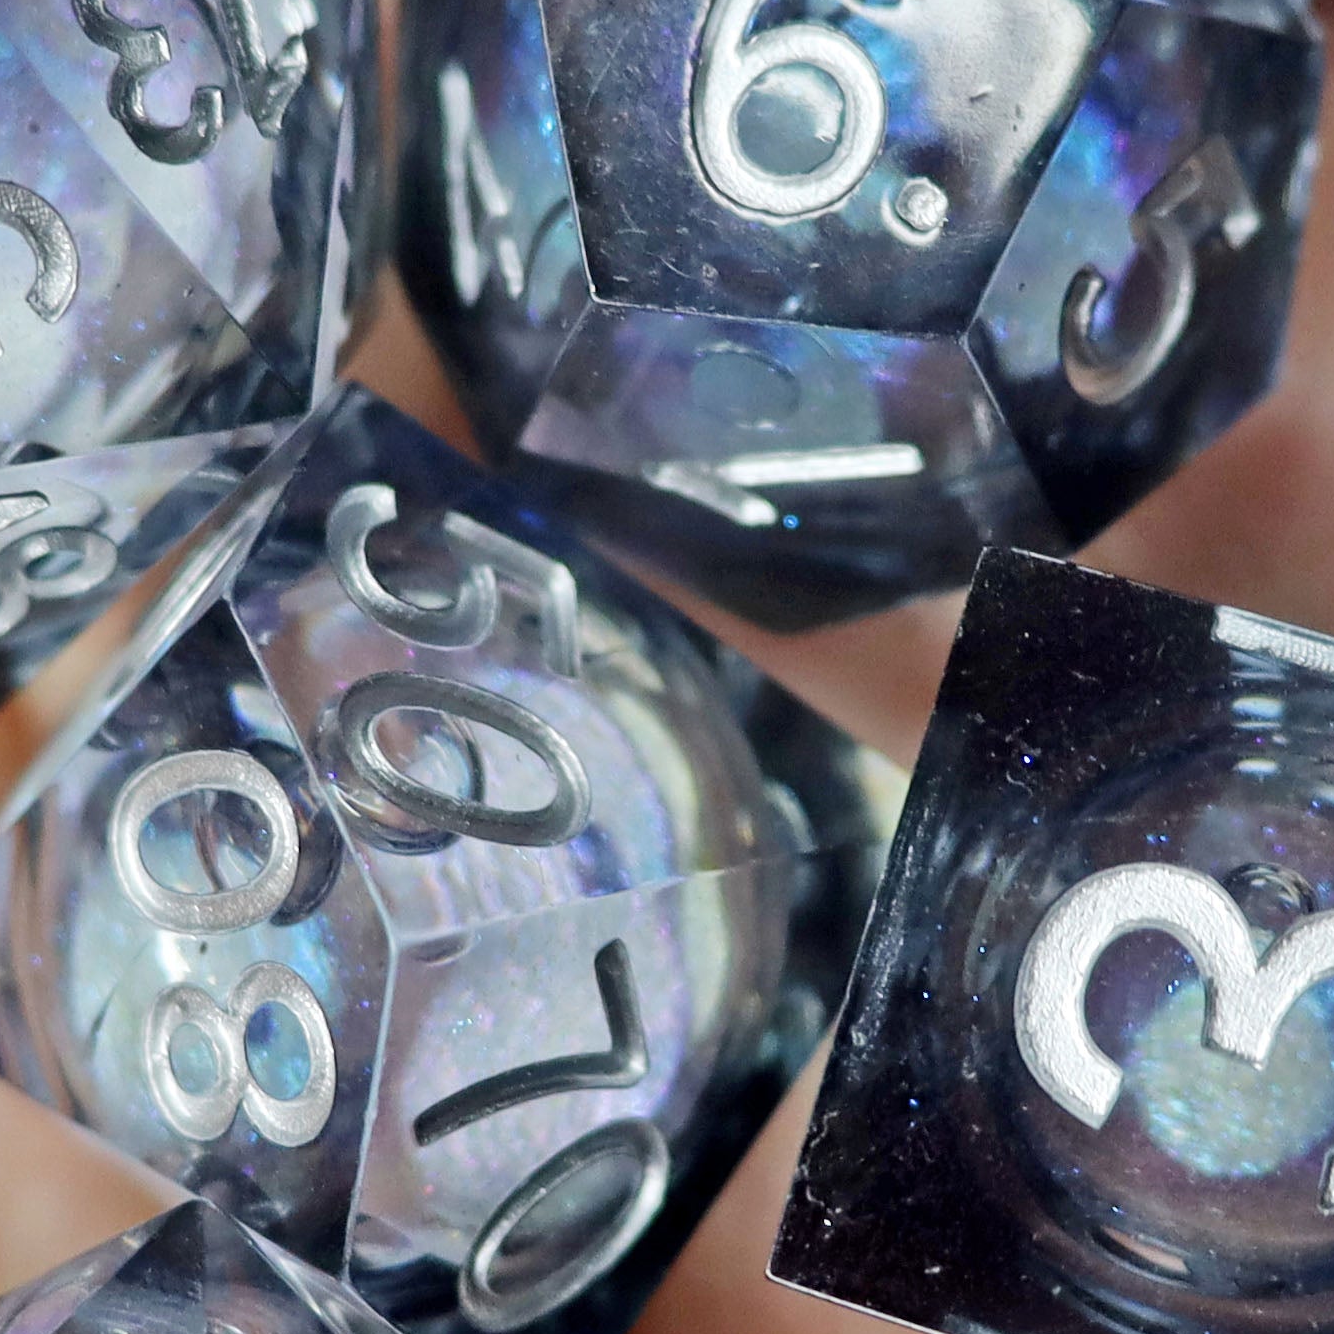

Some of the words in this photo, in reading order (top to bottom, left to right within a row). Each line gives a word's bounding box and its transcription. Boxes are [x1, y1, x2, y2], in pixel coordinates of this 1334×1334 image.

[324, 482, 593, 849] 50
[109, 747, 339, 1149] 80
[410, 935, 671, 1334] 70
